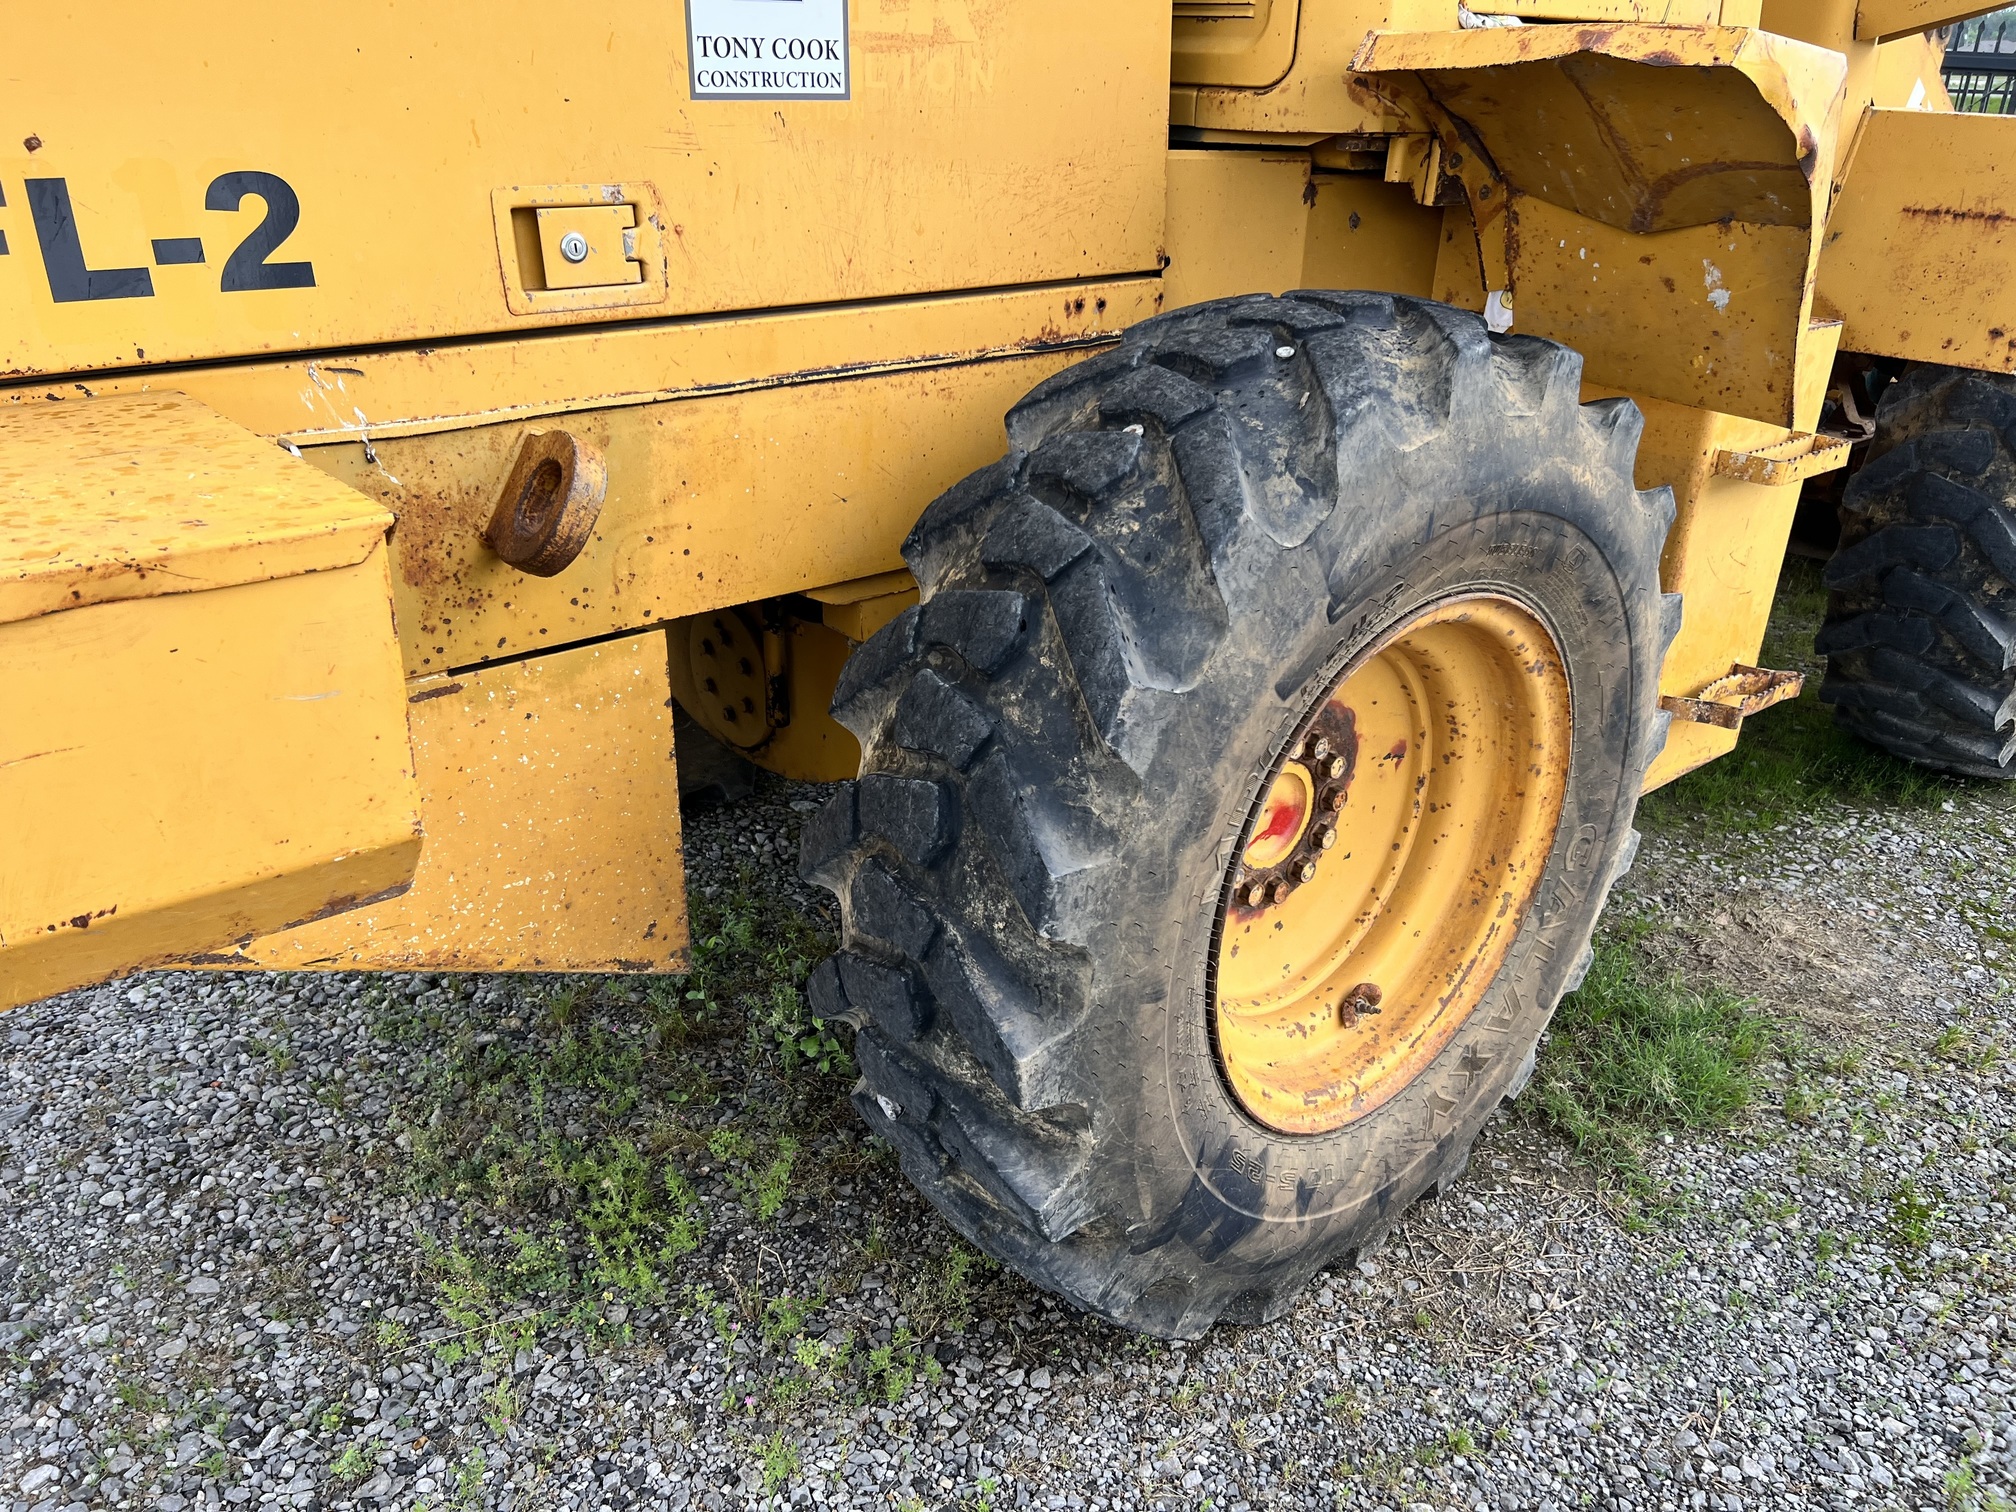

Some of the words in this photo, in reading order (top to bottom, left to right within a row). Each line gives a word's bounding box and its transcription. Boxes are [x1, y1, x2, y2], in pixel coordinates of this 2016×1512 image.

[696, 35, 765, 59] TONY
[771, 37, 840, 61] COOK
[697, 70, 842, 88] CONSTRUCTION
[0, 170, 316, 303] L-2
[1422, 822, 1598, 1141] GALAXY
